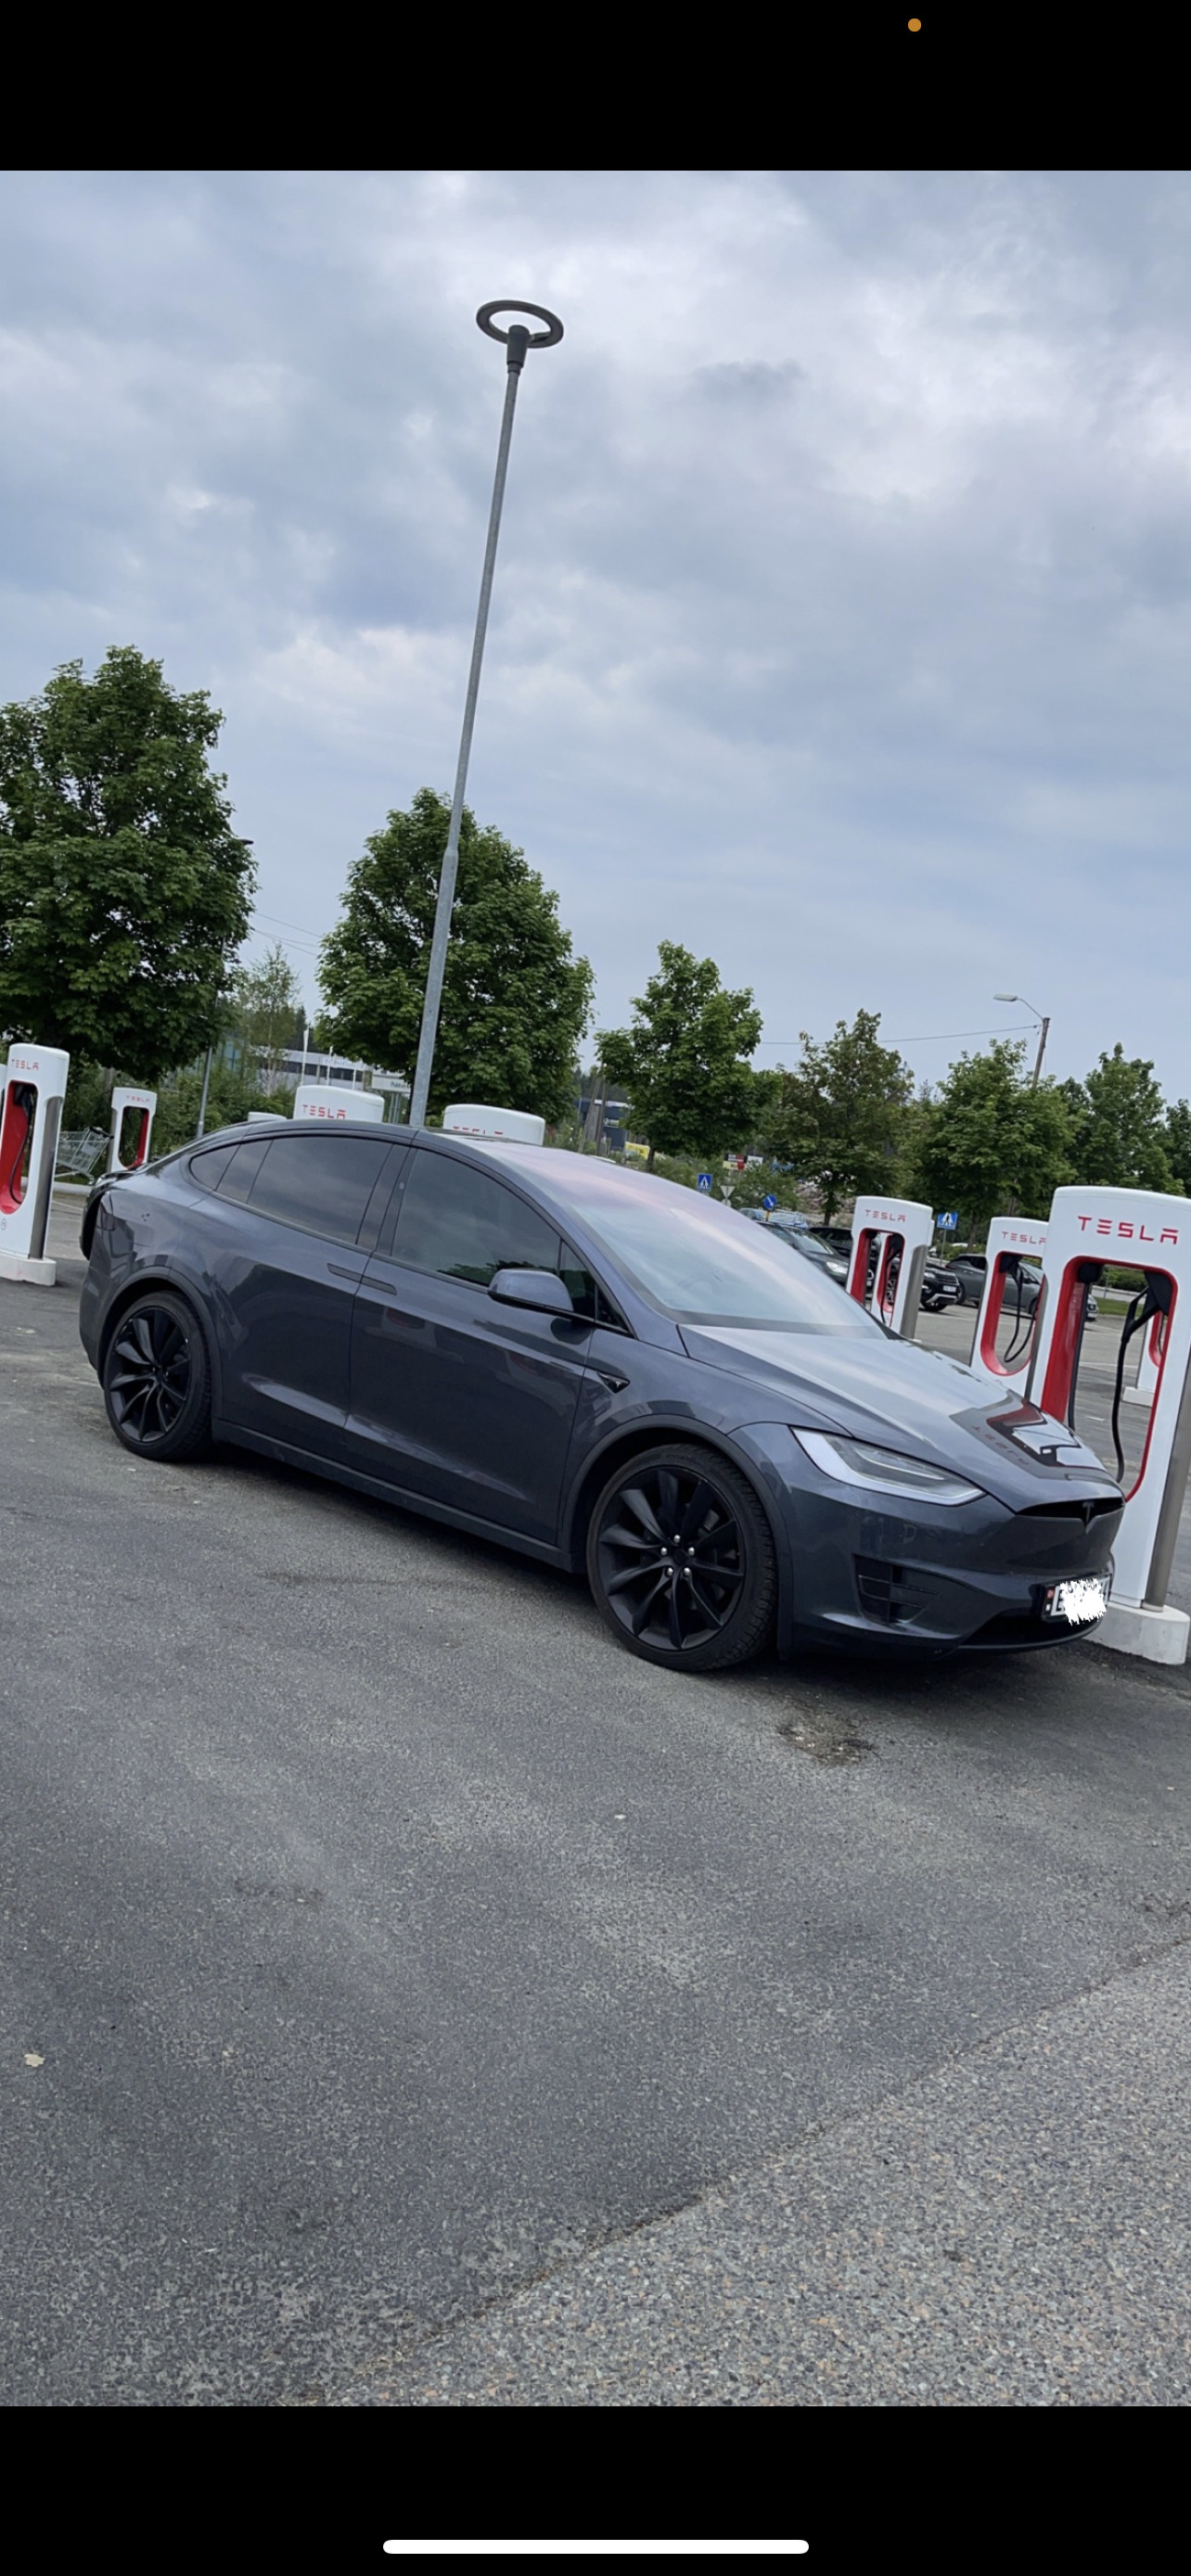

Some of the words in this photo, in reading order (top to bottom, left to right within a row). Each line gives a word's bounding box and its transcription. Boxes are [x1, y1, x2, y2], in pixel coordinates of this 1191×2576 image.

[11, 1059, 40, 1070] TESLA
[302, 1104, 346, 1120] TESLA
[865, 1209, 905, 1223] TESLA
[1078, 1216, 1179, 1245] TESLA
